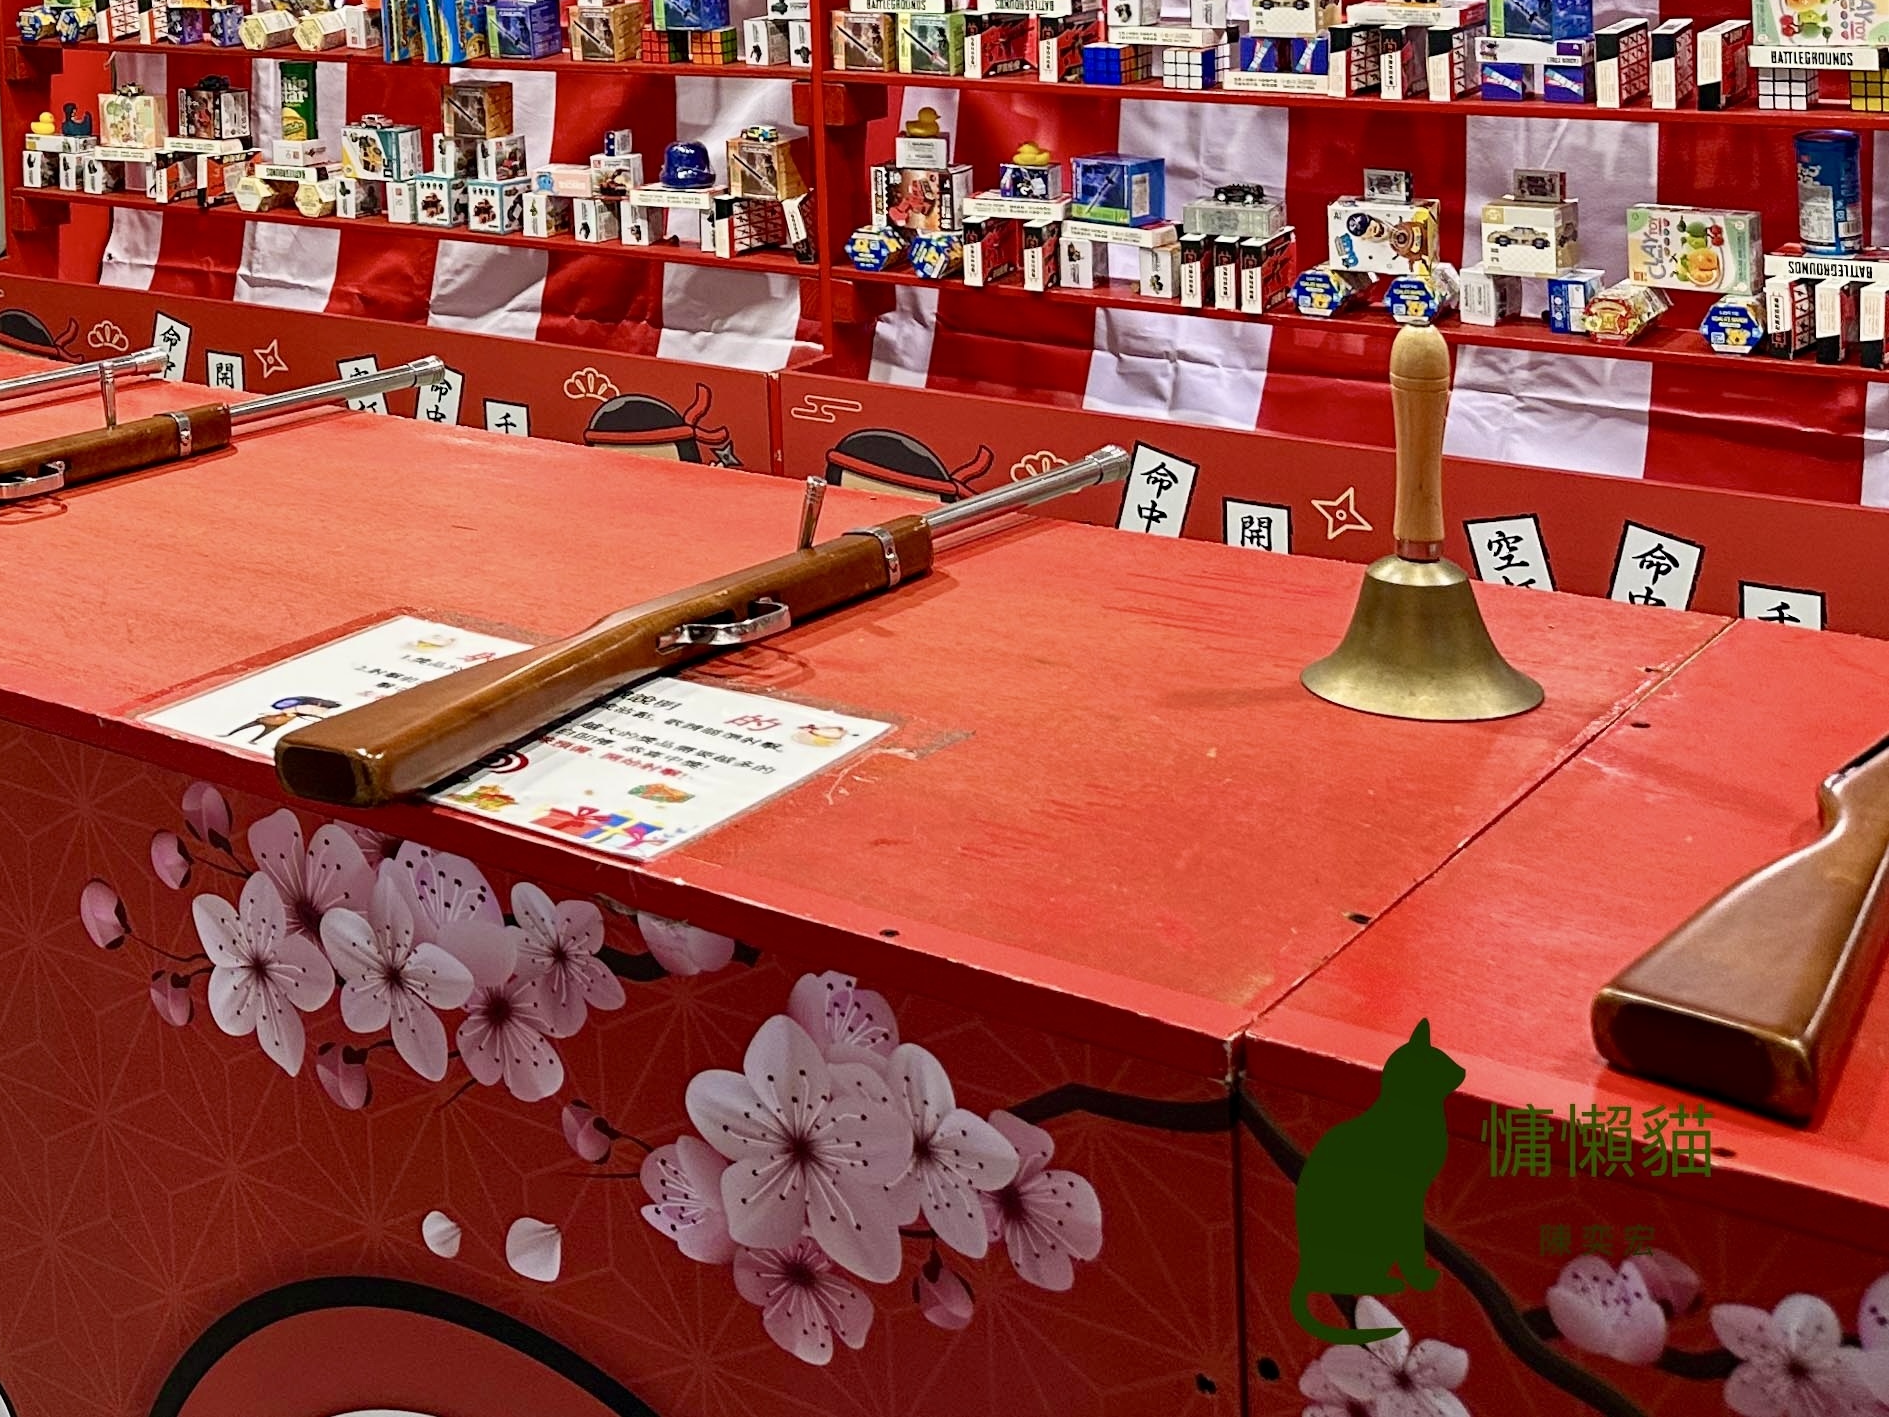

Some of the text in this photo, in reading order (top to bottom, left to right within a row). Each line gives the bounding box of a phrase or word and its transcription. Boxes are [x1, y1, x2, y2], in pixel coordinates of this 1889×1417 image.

[1770, 50, 1854, 66] BATTLEGROUNDS
[1788, 260, 1873, 278] BATTLEGROUNDS
[1130, 461, 1179, 533] 命中
[1240, 515, 1273, 552] 開
